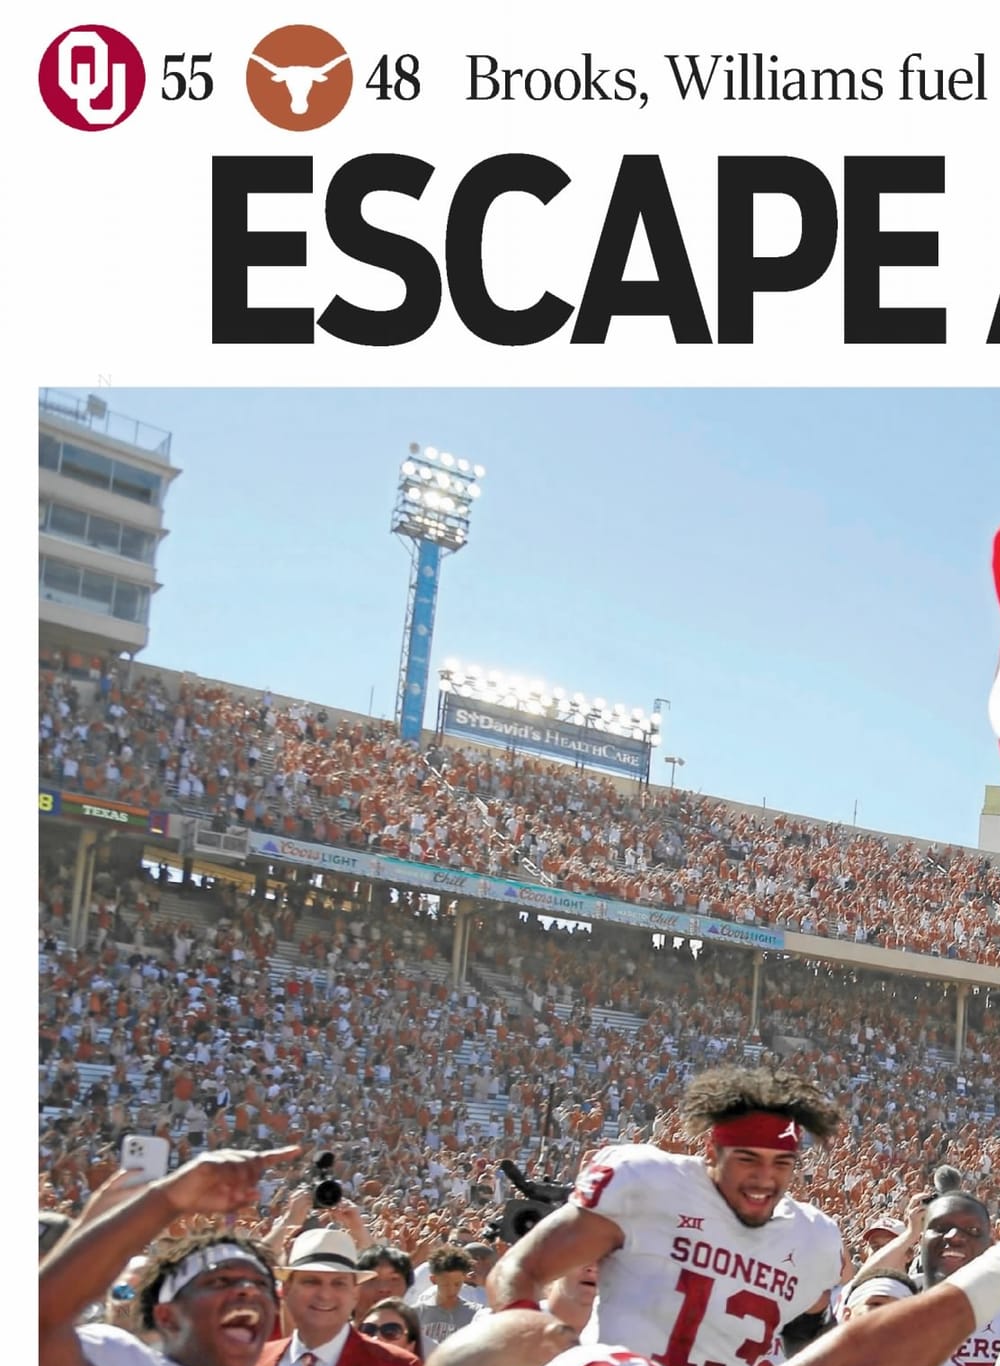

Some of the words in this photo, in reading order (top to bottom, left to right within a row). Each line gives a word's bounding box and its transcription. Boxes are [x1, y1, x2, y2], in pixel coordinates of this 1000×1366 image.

[161, 52, 214, 101] 55
[365, 53, 421, 101] 48
[465, 52, 649, 109] Brooks,
[663, 52, 884, 101] Williams
[899, 52, 988, 101] fuel
[212, 153, 947, 347] ESCAPE
[82, 804, 129, 823] TEXAS
[321, 853, 357, 868] LIGHT
[553, 894, 585, 911] LIGHT
[670, 1236, 799, 1302] SOONERS
